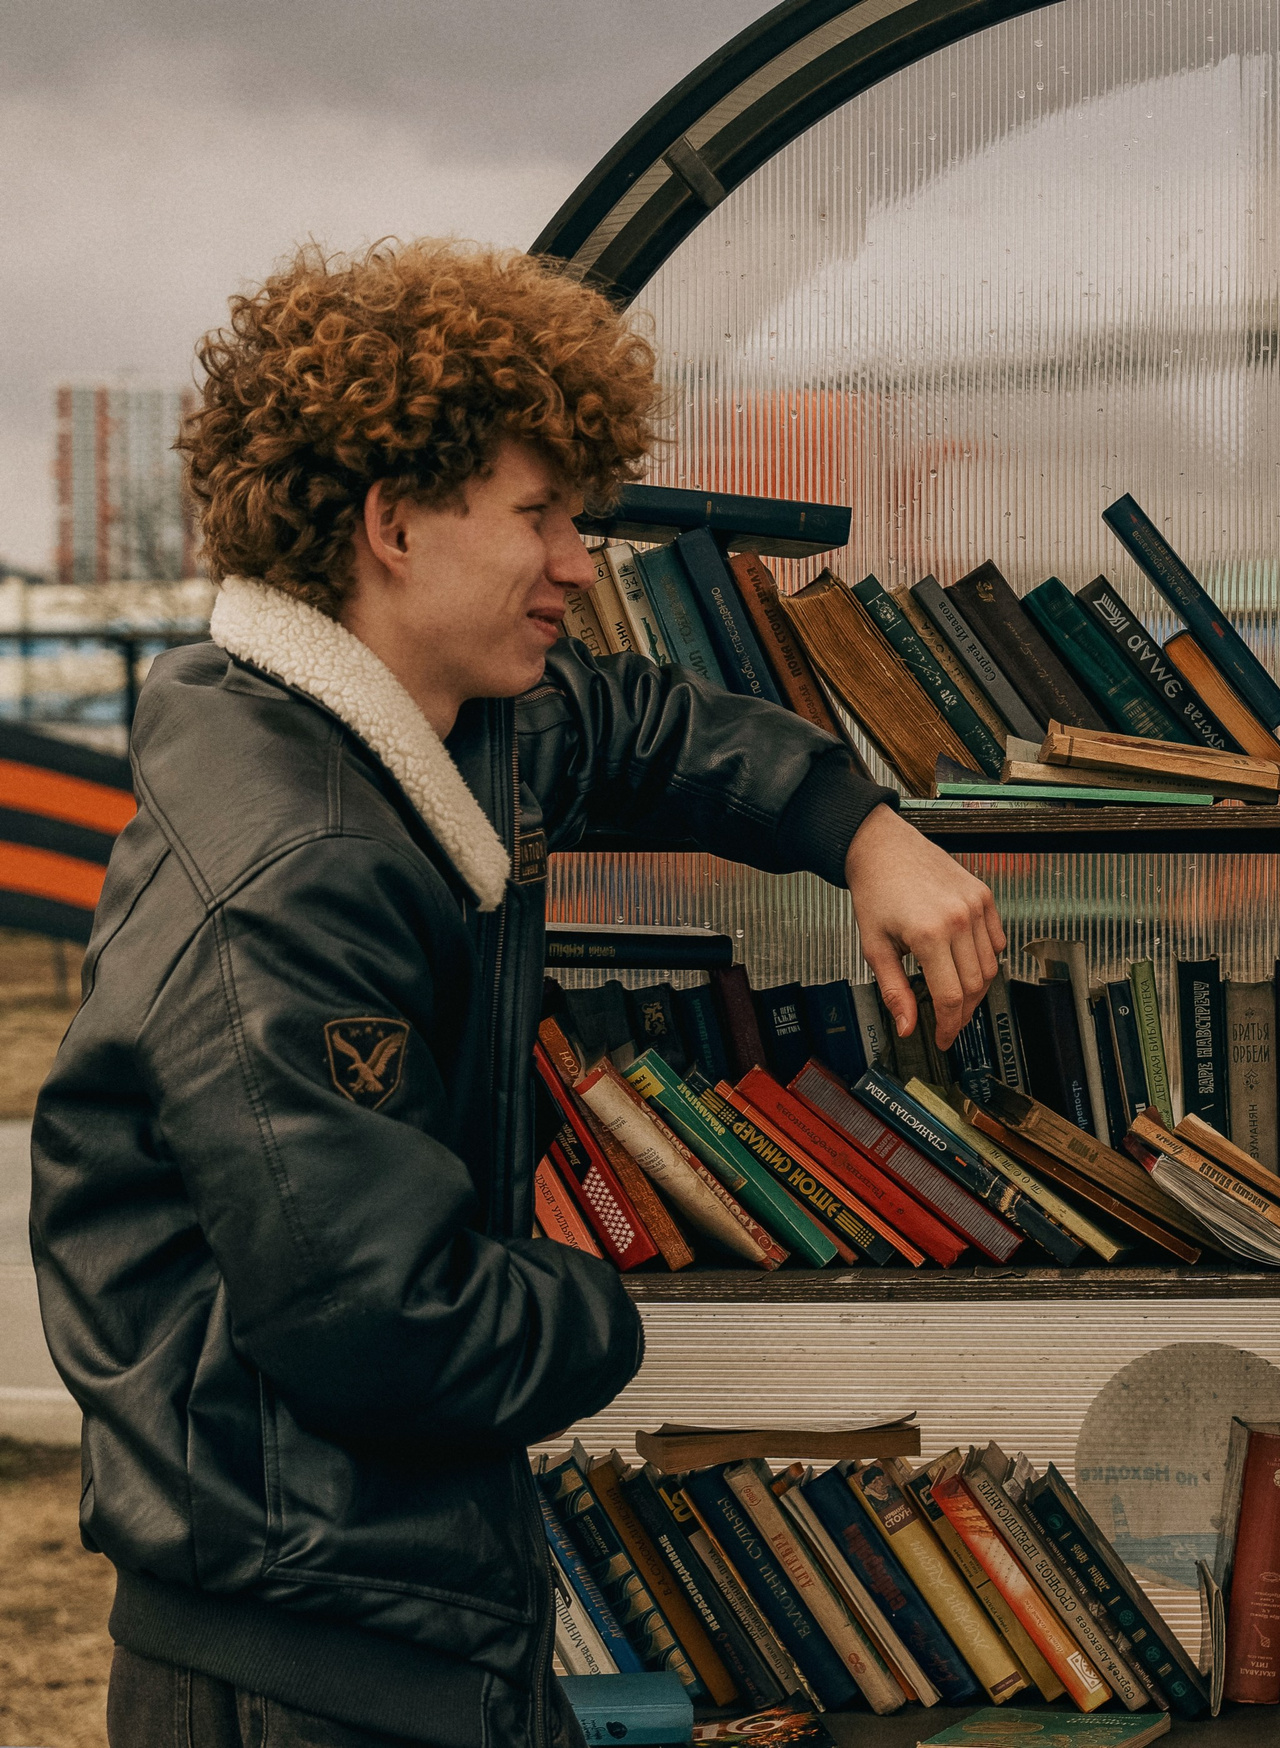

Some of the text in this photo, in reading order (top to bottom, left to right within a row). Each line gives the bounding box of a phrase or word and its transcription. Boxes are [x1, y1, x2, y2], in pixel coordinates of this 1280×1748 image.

[1130, 528, 1192, 607] Слав Хр. Караславов
[745, 565, 802, 678] ПОКА СТОИТ ЗЕМЛЯ
[934, 599, 970, 643] Иванов
[748, 678, 763, 695] по
[964, 641, 999, 683] Сергей
[1123, 630, 1185, 700] ЭМАР
[691, 997, 715, 1074] ЕРГЕЕВ-ЦЕНСКИЙ
[997, 1015, 1017, 1083] ШКОЛА
[1138, 978, 1167, 1103] ДЕТСКАЯ БИБЛИОТЕКА
[1192, 979, 1214, 1094] ЗАРЕ НАВСТРЕЧУ
[1232, 1022, 1269, 1041] БРАТЬЯ
[1232, 1045, 1270, 1063] ОРБЕЛИ
[729, 1115, 795, 1176] СИНКЛЕР
[772, 1099, 848, 1167] еребрякова
[863, 1080, 949, 1153] СТАНИСЛАВ ЛЕМ
[694, 1164, 759, 1234] ХРОНИКИ
[787, 1166, 842, 1218] ЭПТОН
[1197, 1161, 1271, 1213] Александр БЕЛЯЕВ
[582, 1513, 610, 1555] ХАРИТОНОВ
[605, 1486, 662, 1577] СУХОМЛИНСКИЙ
[714, 1494, 765, 1561] СУДЬБЫ
[882, 1503, 906, 1520] ИРВИНГ
[882, 1506, 913, 1529] СТОУН
[976, 1478, 1041, 1560] ПРЕДПИСАНИЕ
[657, 1533, 720, 1631] НЕРАЗГАДАННЫЕ
[770, 1530, 815, 1592] АЛГЕБРА
[1033, 1558, 1078, 1613] СРОЧНОЕ
[706, 1547, 768, 1638] ПРОИЗВЕДЕНИЯ ПРОЗА
[716, 1577, 761, 1643] ДРАМАТИЧЕСКИЕ
[848, 1652, 867, 1674] 8
[1073, 1613, 1111, 1663] Алексеев
[1250, 1660, 1270, 1668] ГИТА
[1105, 1661, 1137, 1701] Сергей
[1239, 1668, 1277, 1677] БХАГАВАД
